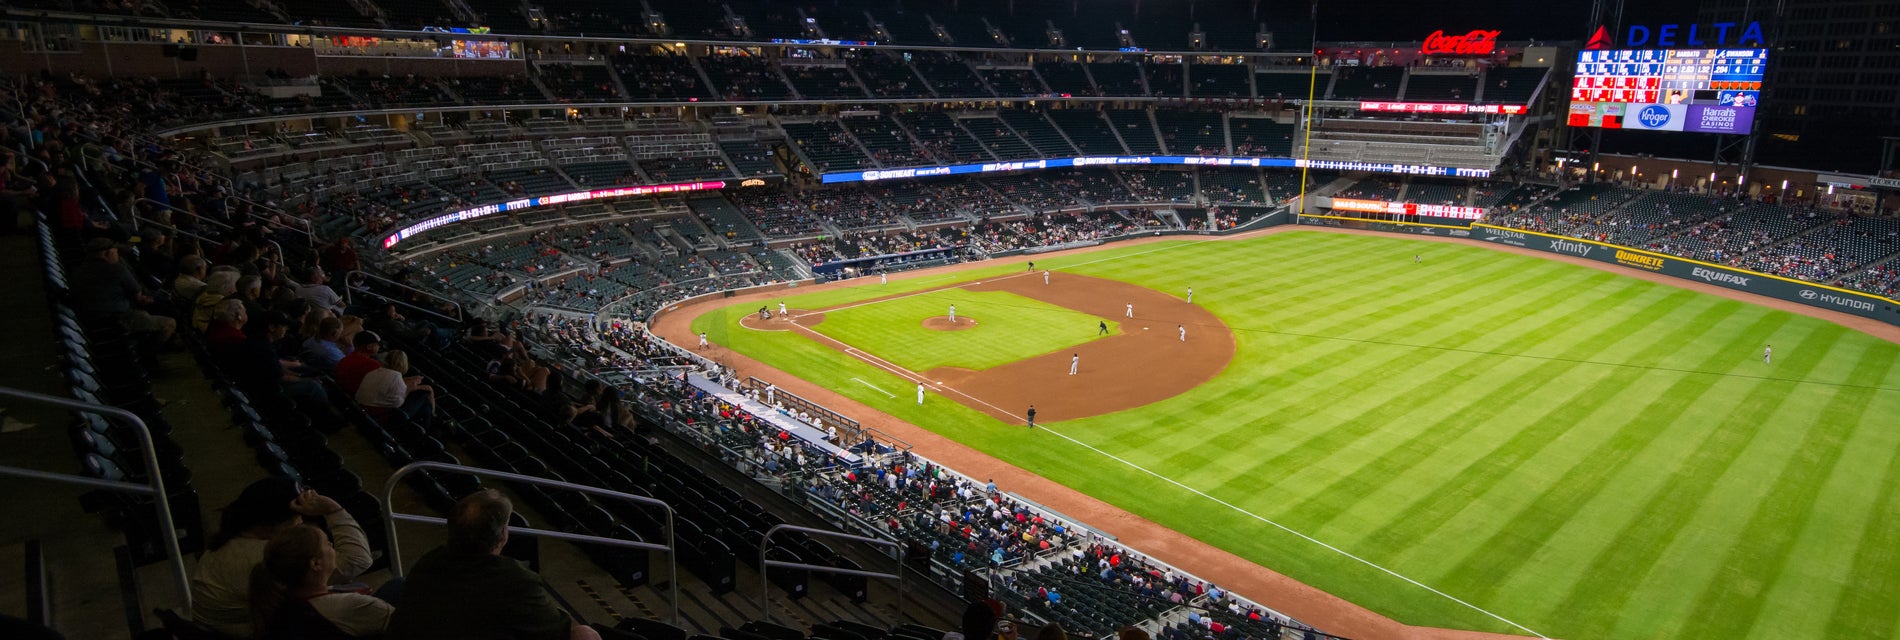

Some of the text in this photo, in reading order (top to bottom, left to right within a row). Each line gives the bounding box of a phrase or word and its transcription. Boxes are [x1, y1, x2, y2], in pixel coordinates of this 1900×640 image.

[1627, 21, 1764, 46] DELTA
[1582, 52, 1593, 62] NL
[1578, 78, 1588, 87] AL
[1641, 108, 1668, 126] Kroger
[1703, 107, 1736, 116] Harrah's
[880, 169, 915, 179] SOUTHEAST
[1485, 228, 1526, 239] WELLSTAR
[1550, 239, 1592, 256] xfinity
[1615, 250, 1664, 267] QUIKRETE
[1692, 267, 1752, 286] EQUIFAX
[1820, 294, 1874, 311] HYUNDAI
